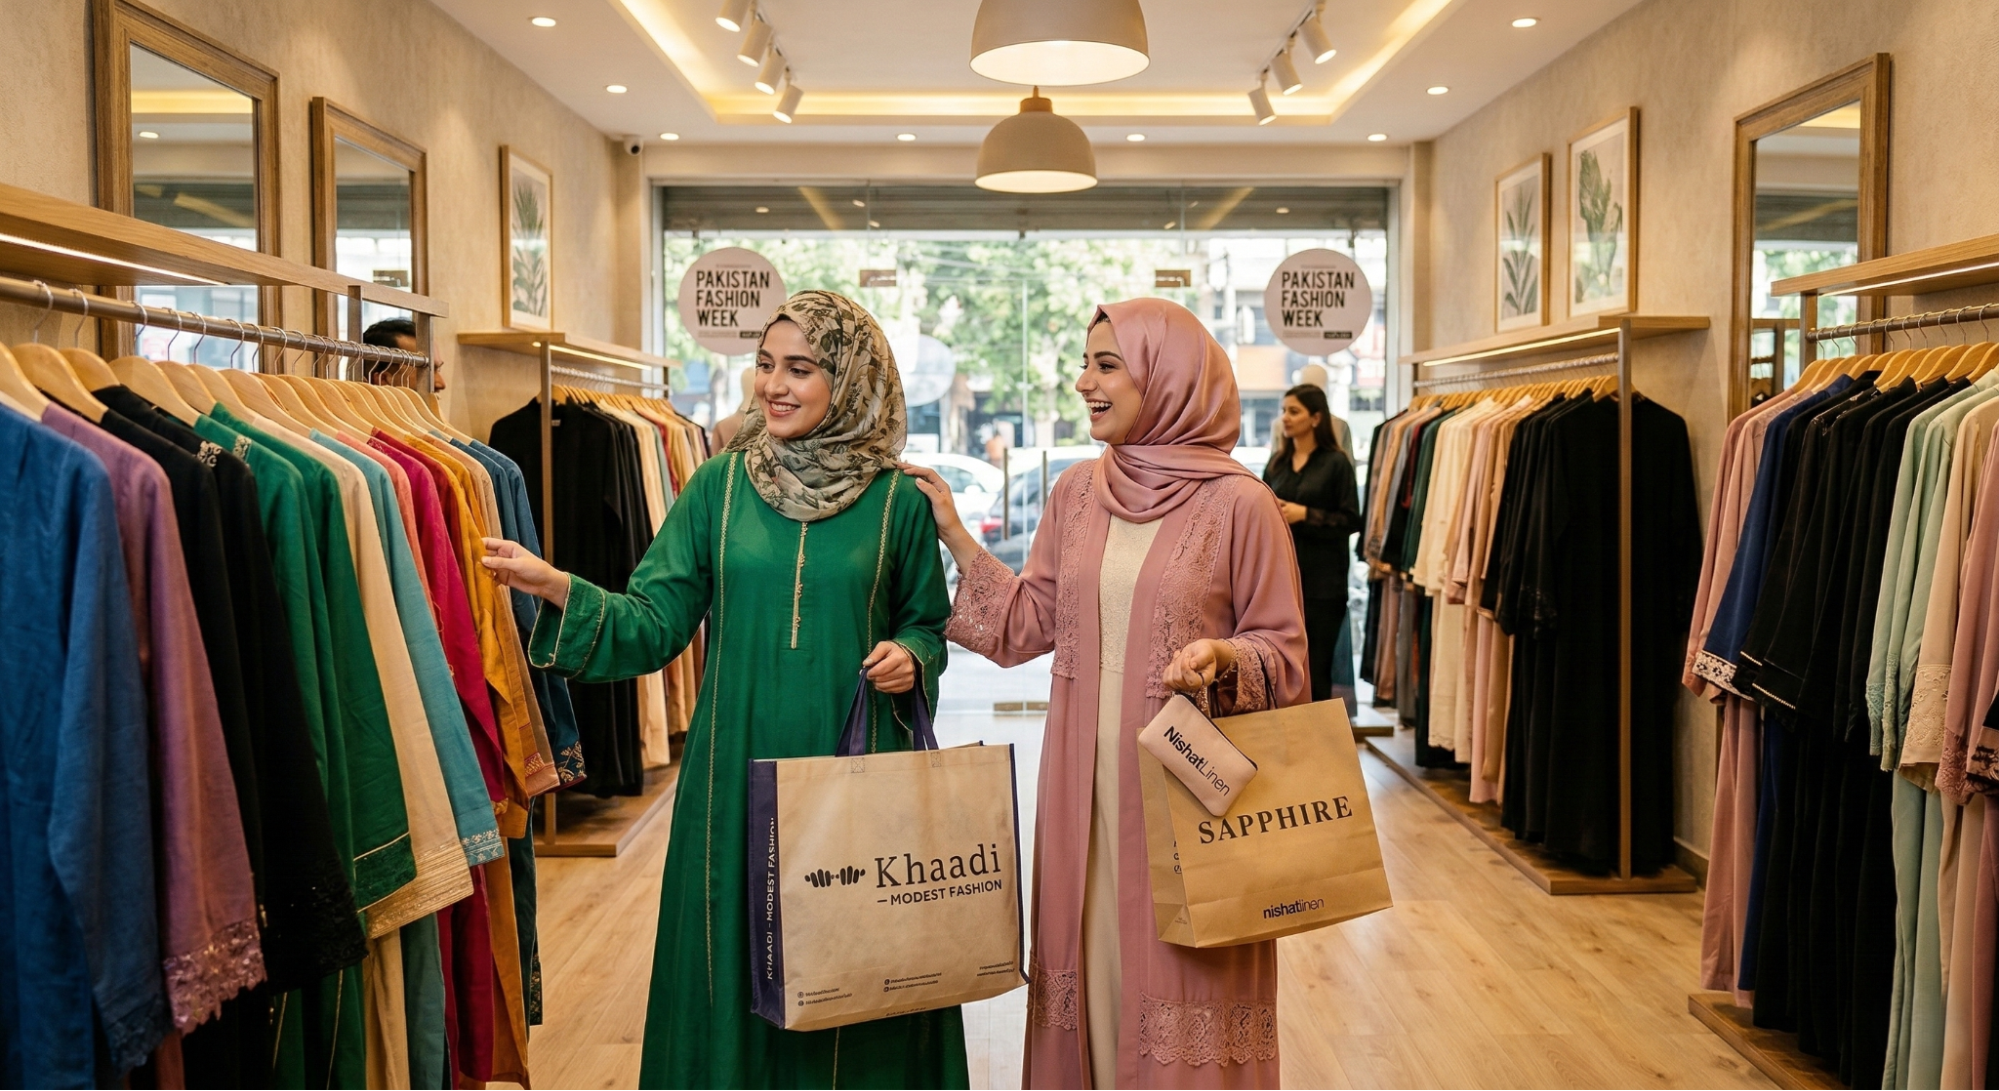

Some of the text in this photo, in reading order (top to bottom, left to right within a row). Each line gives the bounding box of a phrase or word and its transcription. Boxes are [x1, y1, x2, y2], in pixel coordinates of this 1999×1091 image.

[696, 270, 770, 289] PAKISTAN
[1281, 271, 1355, 289] PAKISTAN
[696, 290, 761, 308] FASHION
[1281, 290, 1345, 308] FASHION
[696, 309, 739, 327] WEEK
[1281, 310, 1323, 328] WEEK
[1163, 725, 1231, 797] NishatLinen
[1198, 796, 1353, 844] SAPPHIRE
[768, 817, 776, 868] FASHIO
[874, 843, 1001, 889] Khaadi
[766, 871, 775, 921] MODEST
[890, 879, 1003, 906] MODEST FASHION
[1263, 898, 1325, 919] nishatlinen
